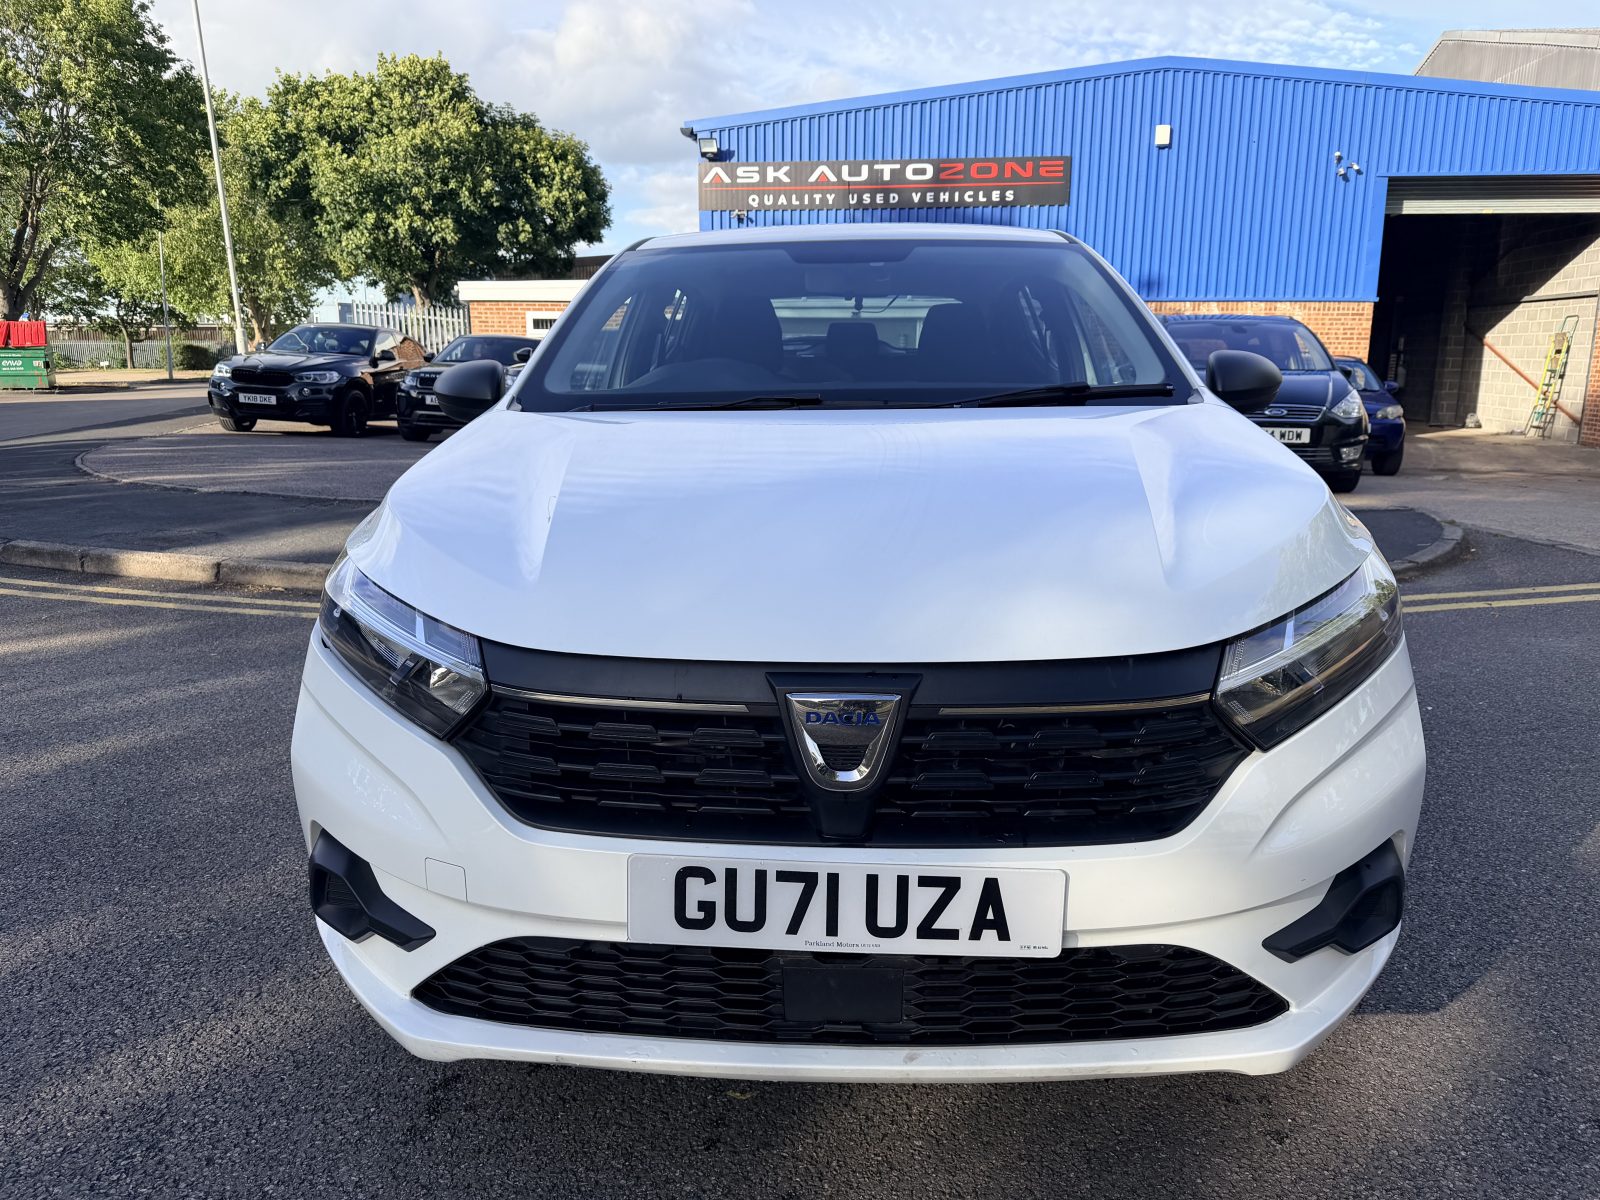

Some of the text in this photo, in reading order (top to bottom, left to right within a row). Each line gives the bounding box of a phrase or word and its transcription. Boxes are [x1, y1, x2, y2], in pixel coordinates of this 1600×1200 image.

[702, 160, 1065, 184] ASK AUTOZONE
[747, 189, 1016, 208] QUALITY USED VEHICLES
[243, 395, 273, 403] YK18 DKE
[1279, 430, 1303, 441] WDW
[805, 711, 881, 726] DACIA
[673, 865, 1012, 942] GU71 UZA
